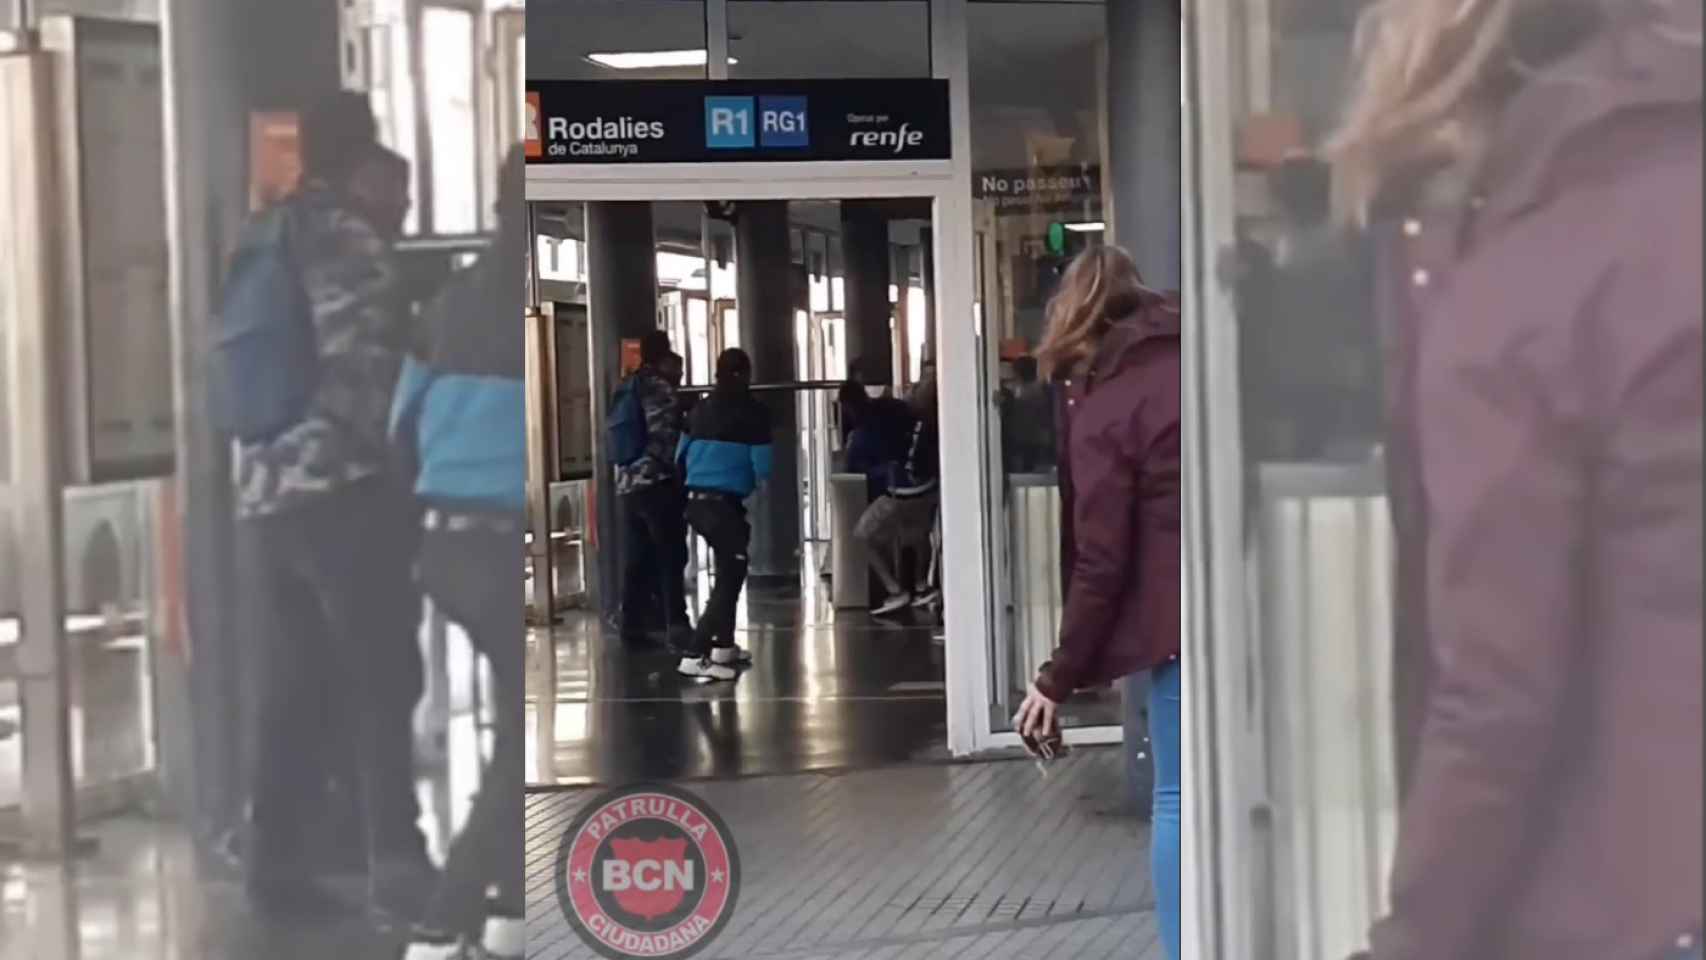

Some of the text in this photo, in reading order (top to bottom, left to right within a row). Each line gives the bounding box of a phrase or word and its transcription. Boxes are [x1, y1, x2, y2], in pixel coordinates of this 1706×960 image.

[548, 116, 664, 140] Rodalies
[712, 107, 748, 136] R1
[763, 110, 804, 132] RG1
[850, 122, 923, 153] renfe
[548, 142, 638, 157] de Catalunya
[982, 176, 1008, 192] No
